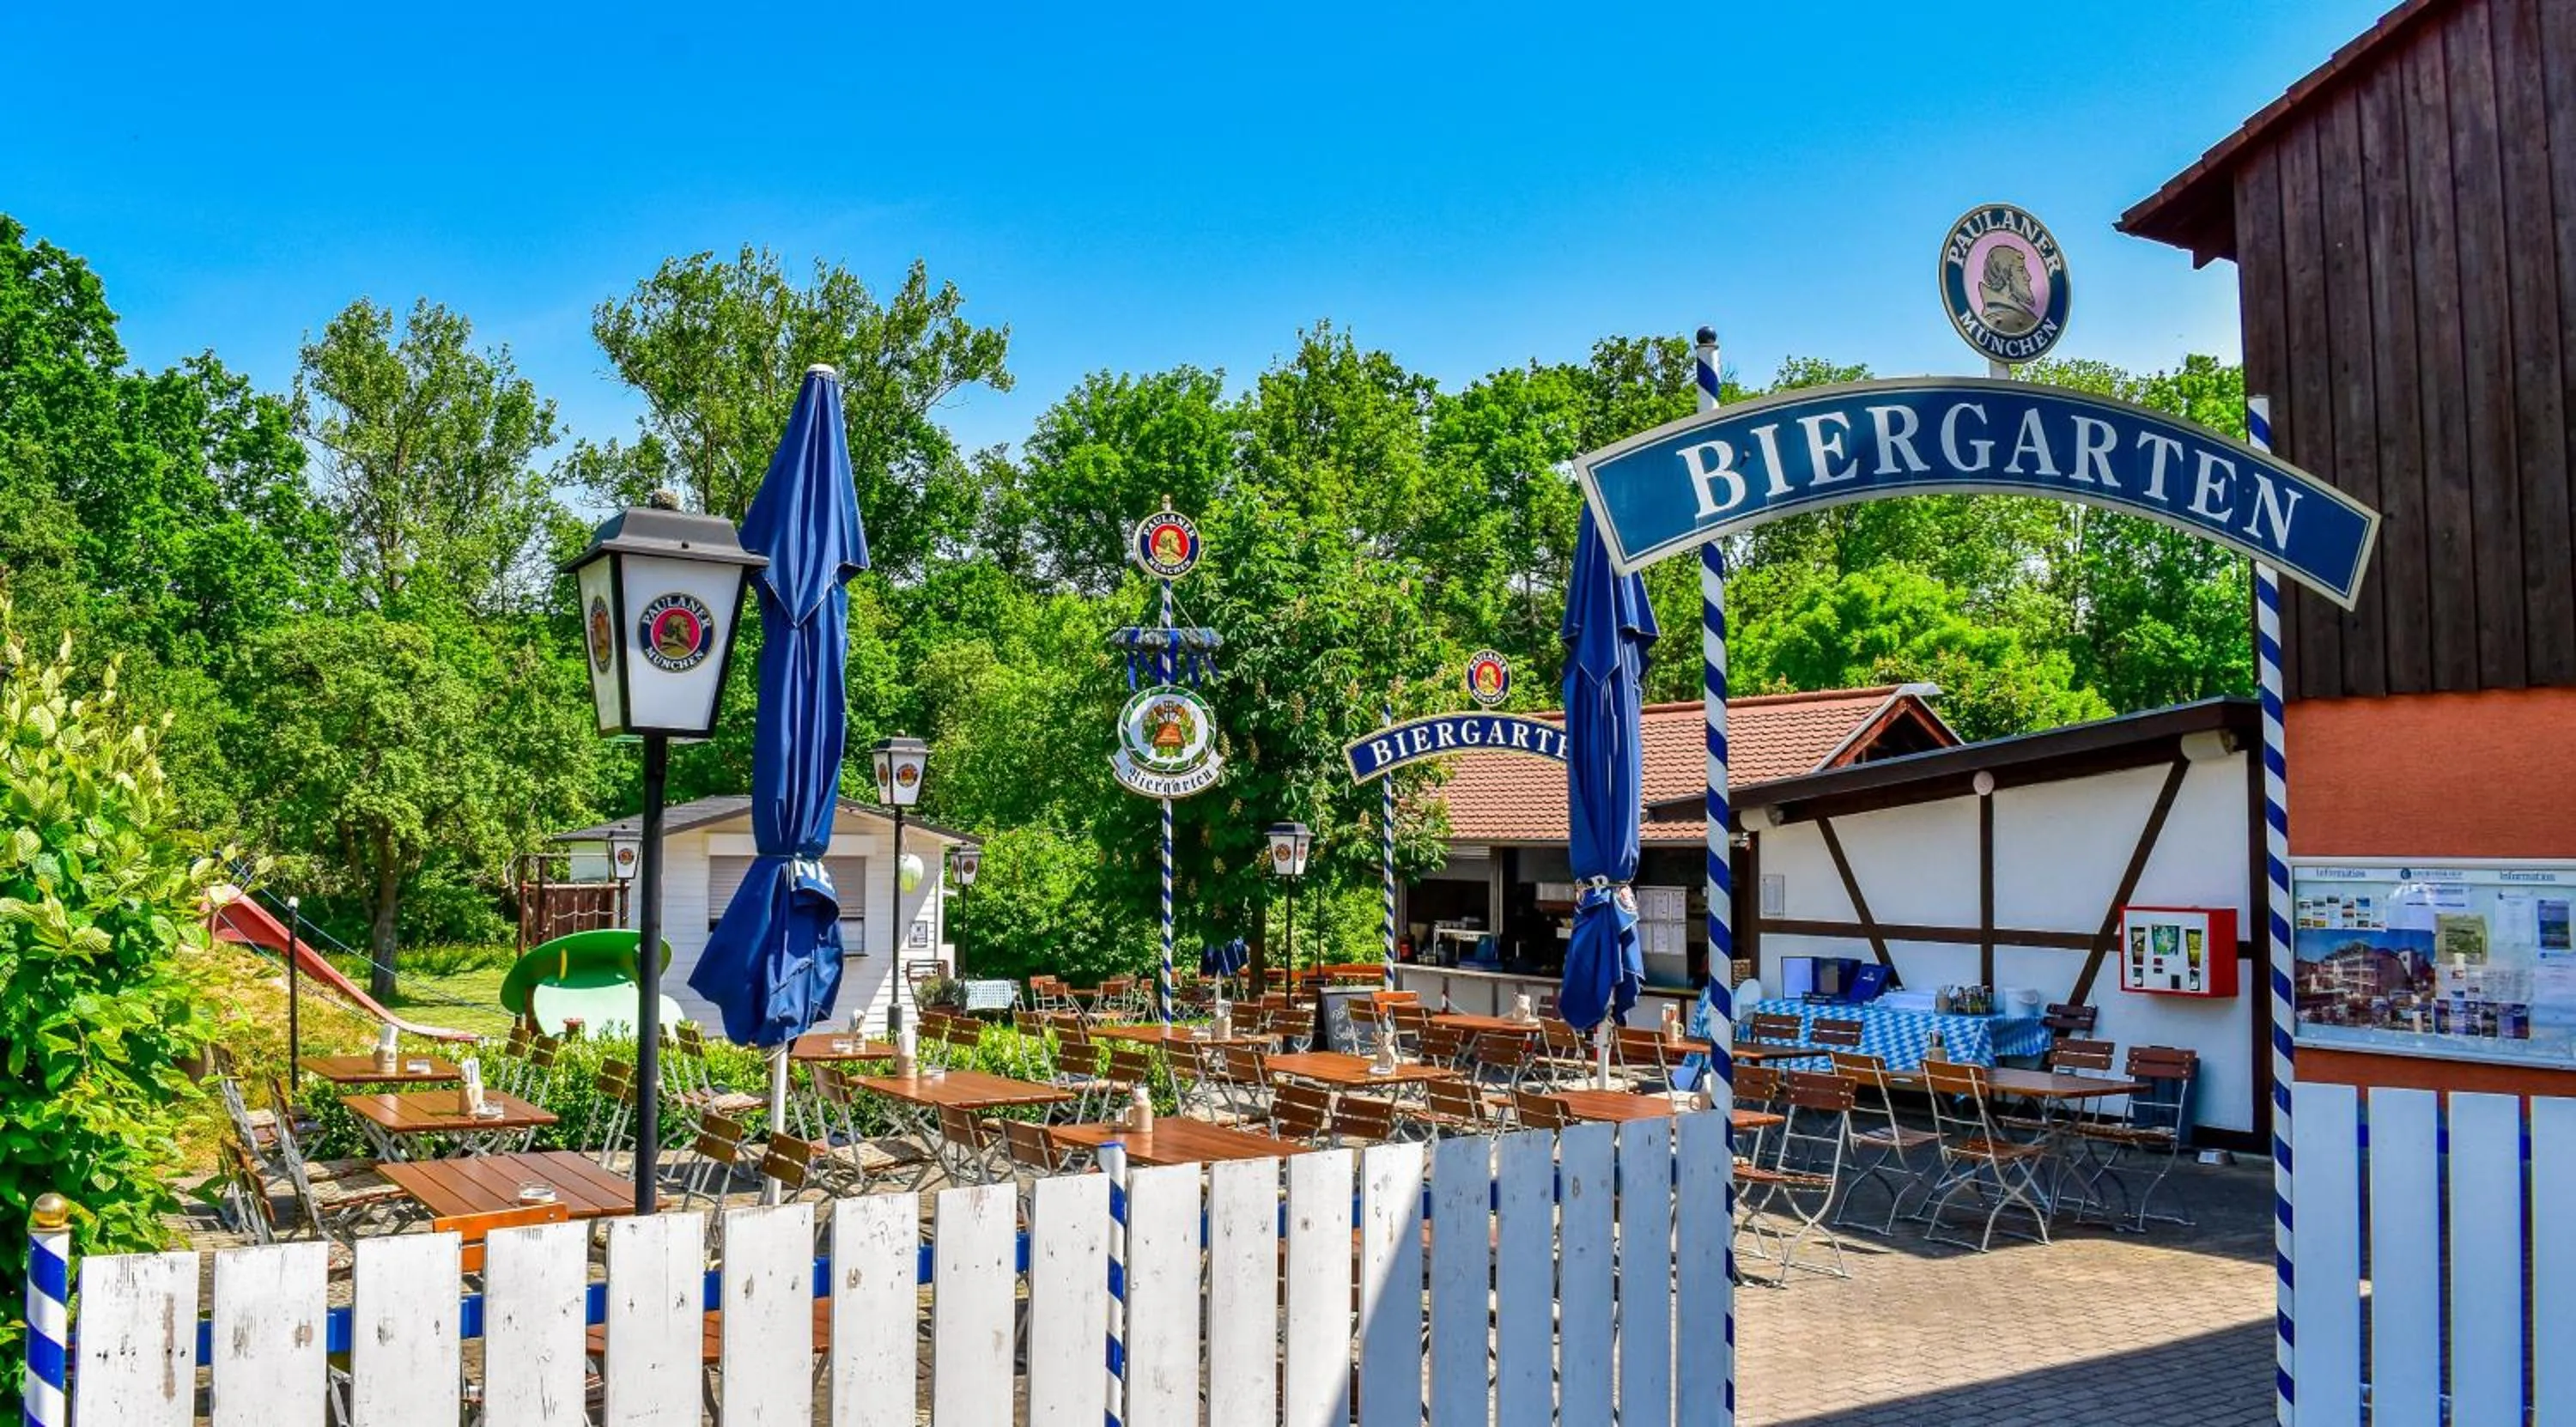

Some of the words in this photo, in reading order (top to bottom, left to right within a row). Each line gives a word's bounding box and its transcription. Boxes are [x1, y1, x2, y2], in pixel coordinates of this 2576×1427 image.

[1947, 211, 2063, 276] PAULANER
[1676, 402, 2305, 552] BIERGARTEN
[1144, 514, 1196, 538] PAULANER
[641, 597, 712, 629] PAULANER
[1369, 719, 1567, 767] BIERGARTE
[1127, 768, 1212, 795] Biergarten
